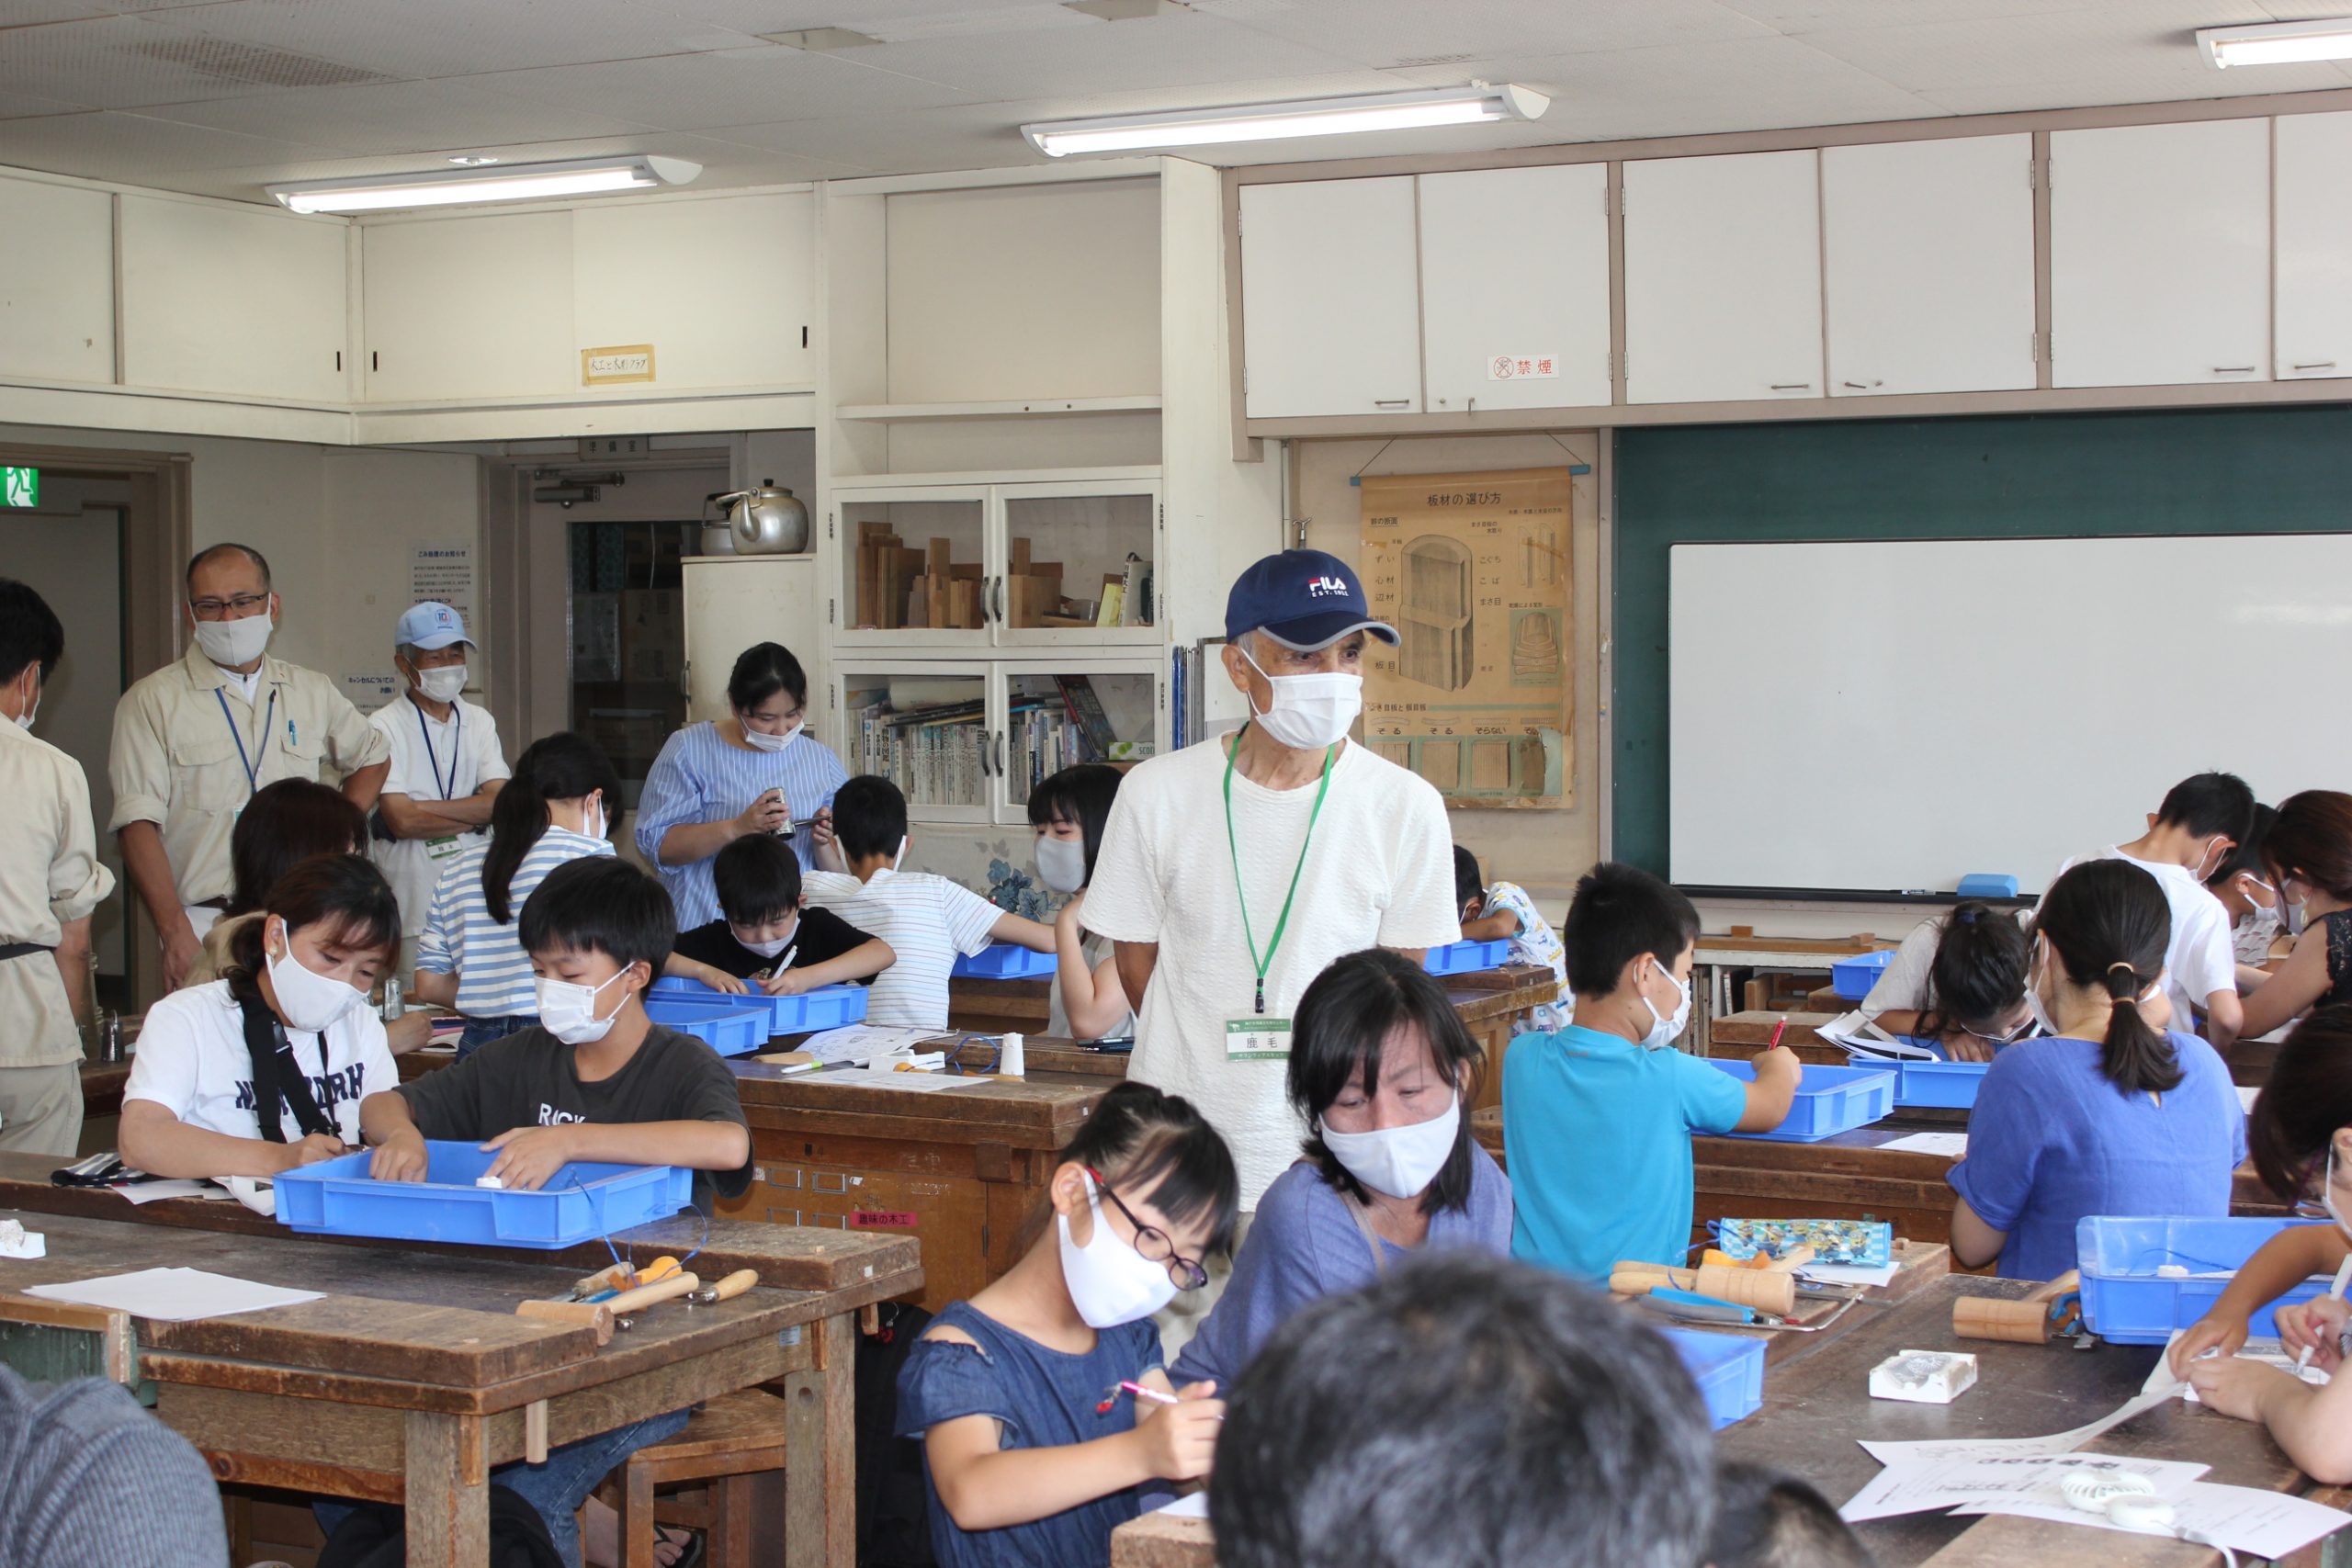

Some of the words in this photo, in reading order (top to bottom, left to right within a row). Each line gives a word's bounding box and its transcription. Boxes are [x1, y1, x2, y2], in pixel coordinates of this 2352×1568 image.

[1517, 359, 1552, 375] 禁煙
[1428, 492, 1502, 506] 板材の選び方
[1308, 576, 1347, 592] FILA
[1312, 590, 1332, 598] EST.
[1480, 597, 1501, 606] まさ目
[1476, 727, 1507, 735] そらない
[1247, 1036, 1278, 1049] 鹿毛
[859, 1213, 910, 1225] 趣味の木工
